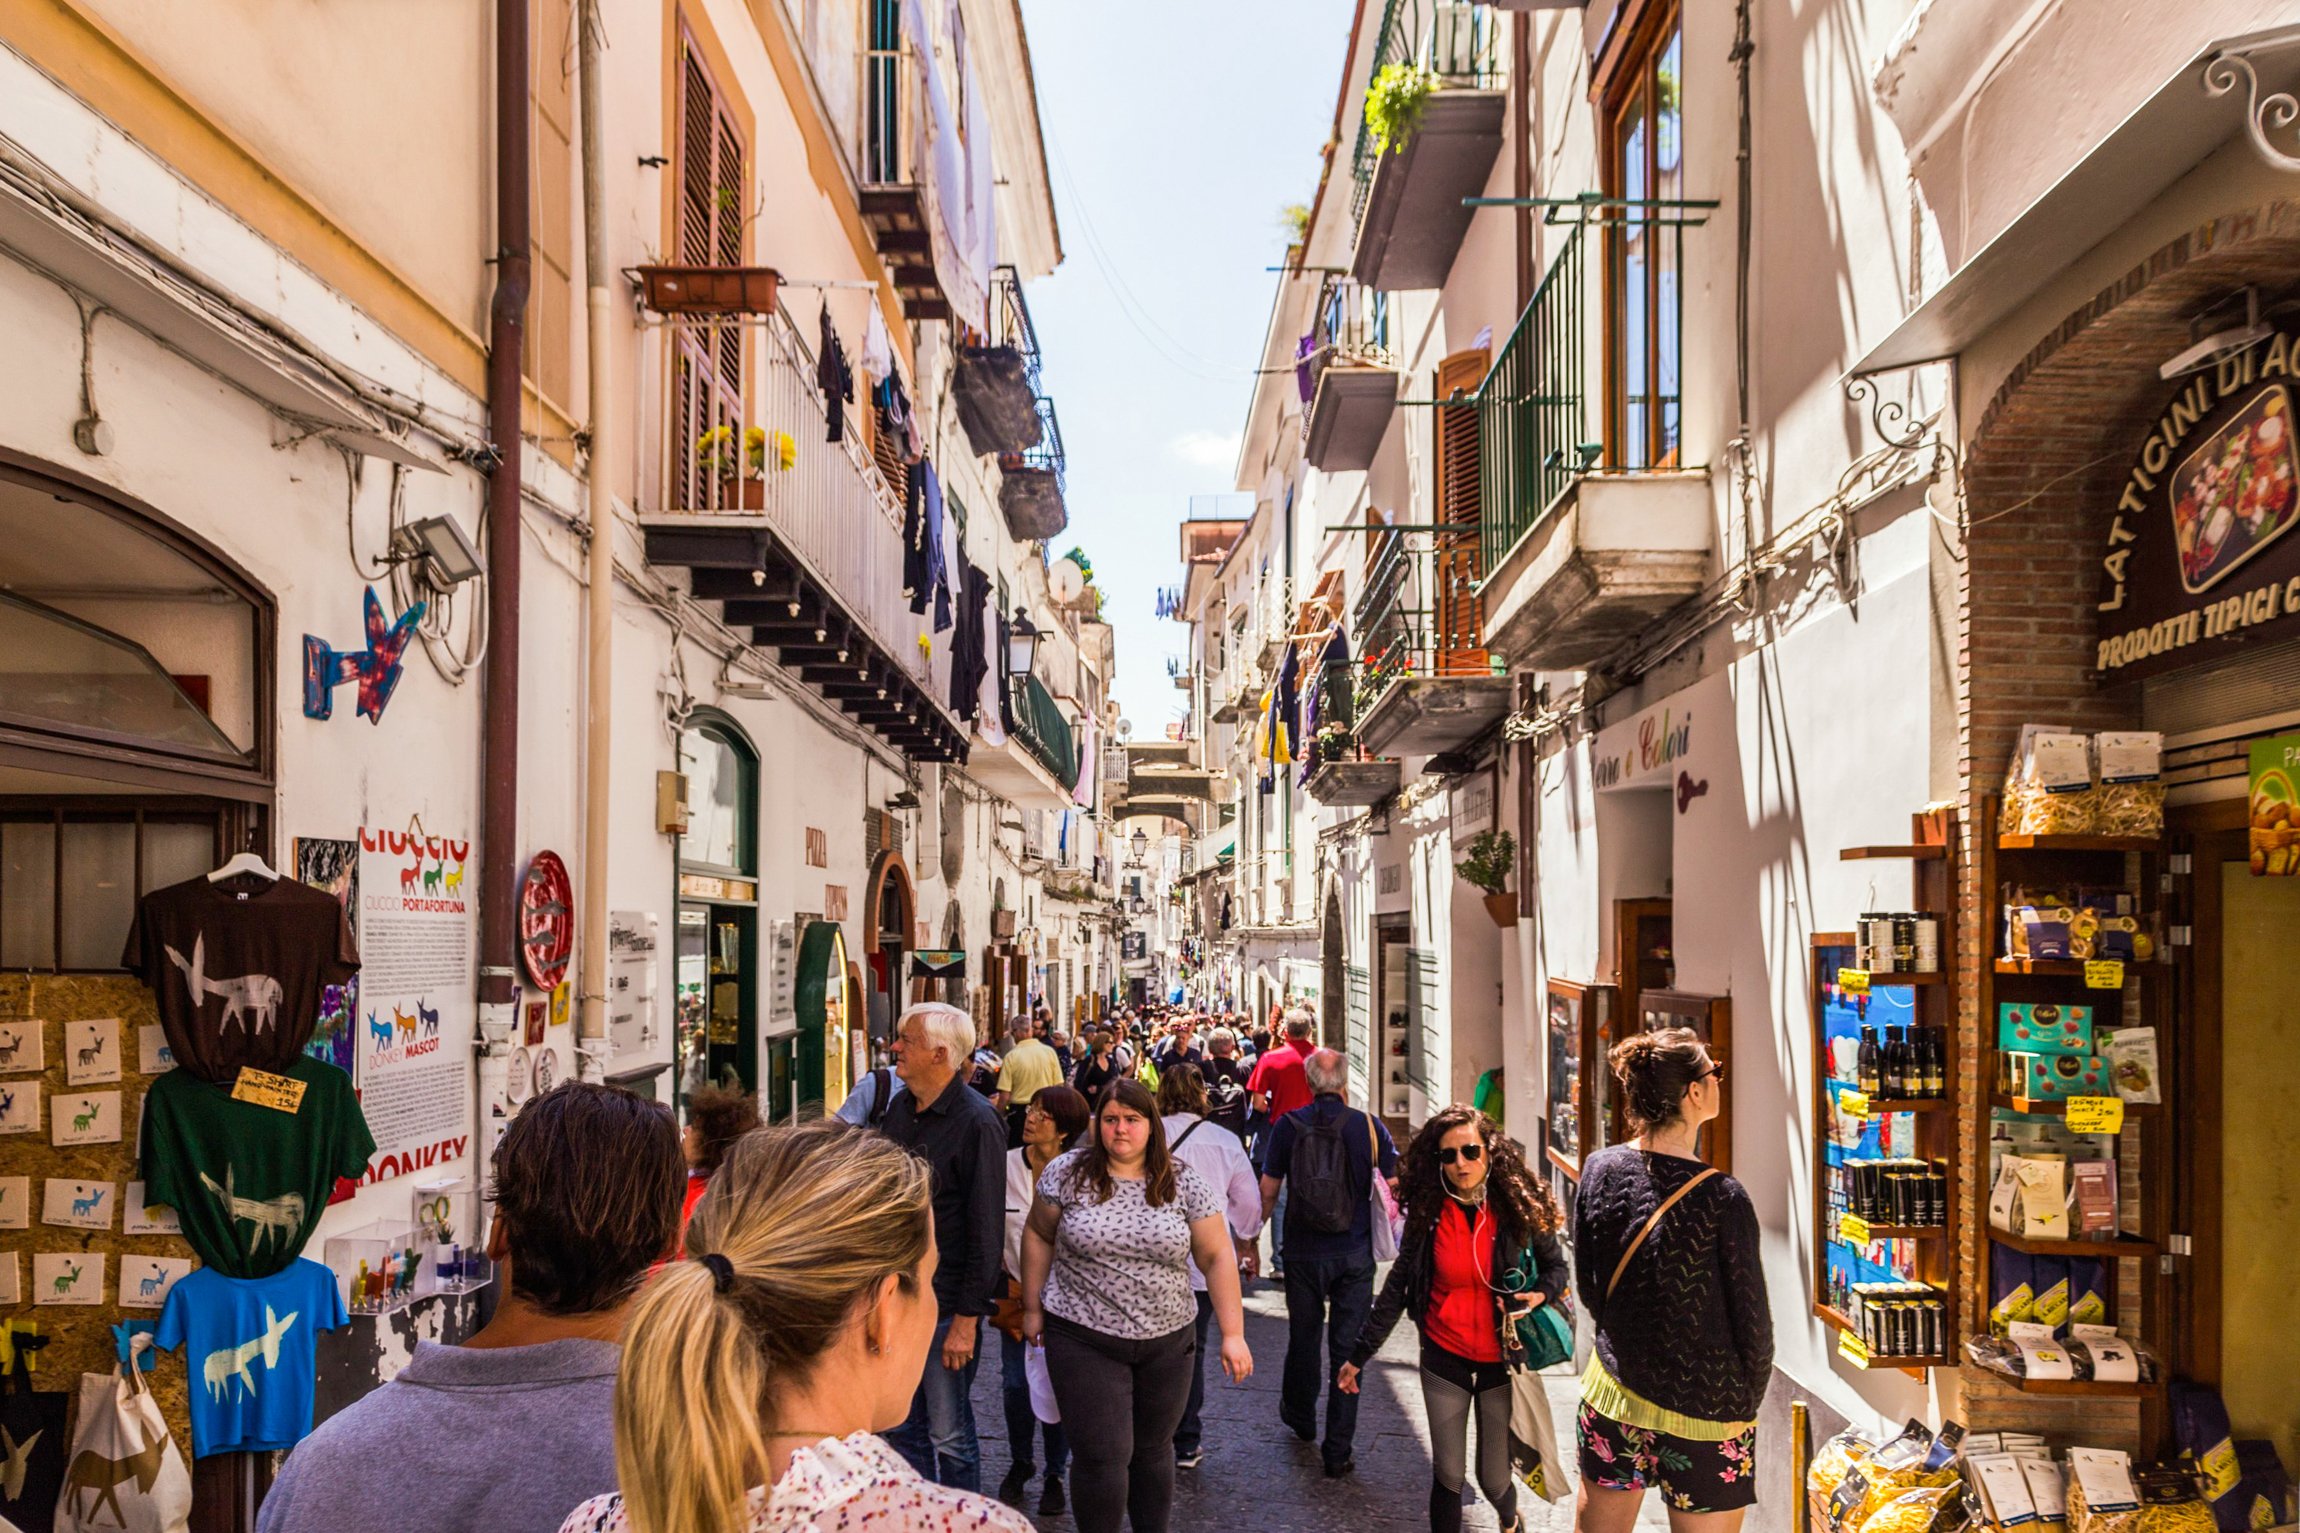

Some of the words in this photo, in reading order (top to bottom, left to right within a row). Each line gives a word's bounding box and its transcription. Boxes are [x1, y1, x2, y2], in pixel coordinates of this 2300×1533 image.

[2099, 375, 2212, 612] LATTICINI
[2217, 350, 2253, 397] DI
[2097, 609, 2200, 671] PRODOTTI
[2203, 583, 2281, 639] TIPICI
[1638, 708, 1692, 770] Colori
[403, 898, 466, 914] PORTAFORTUNA
[369, 1048, 402, 1070] DONKEY
[405, 1037, 440, 1059] MASCOT
